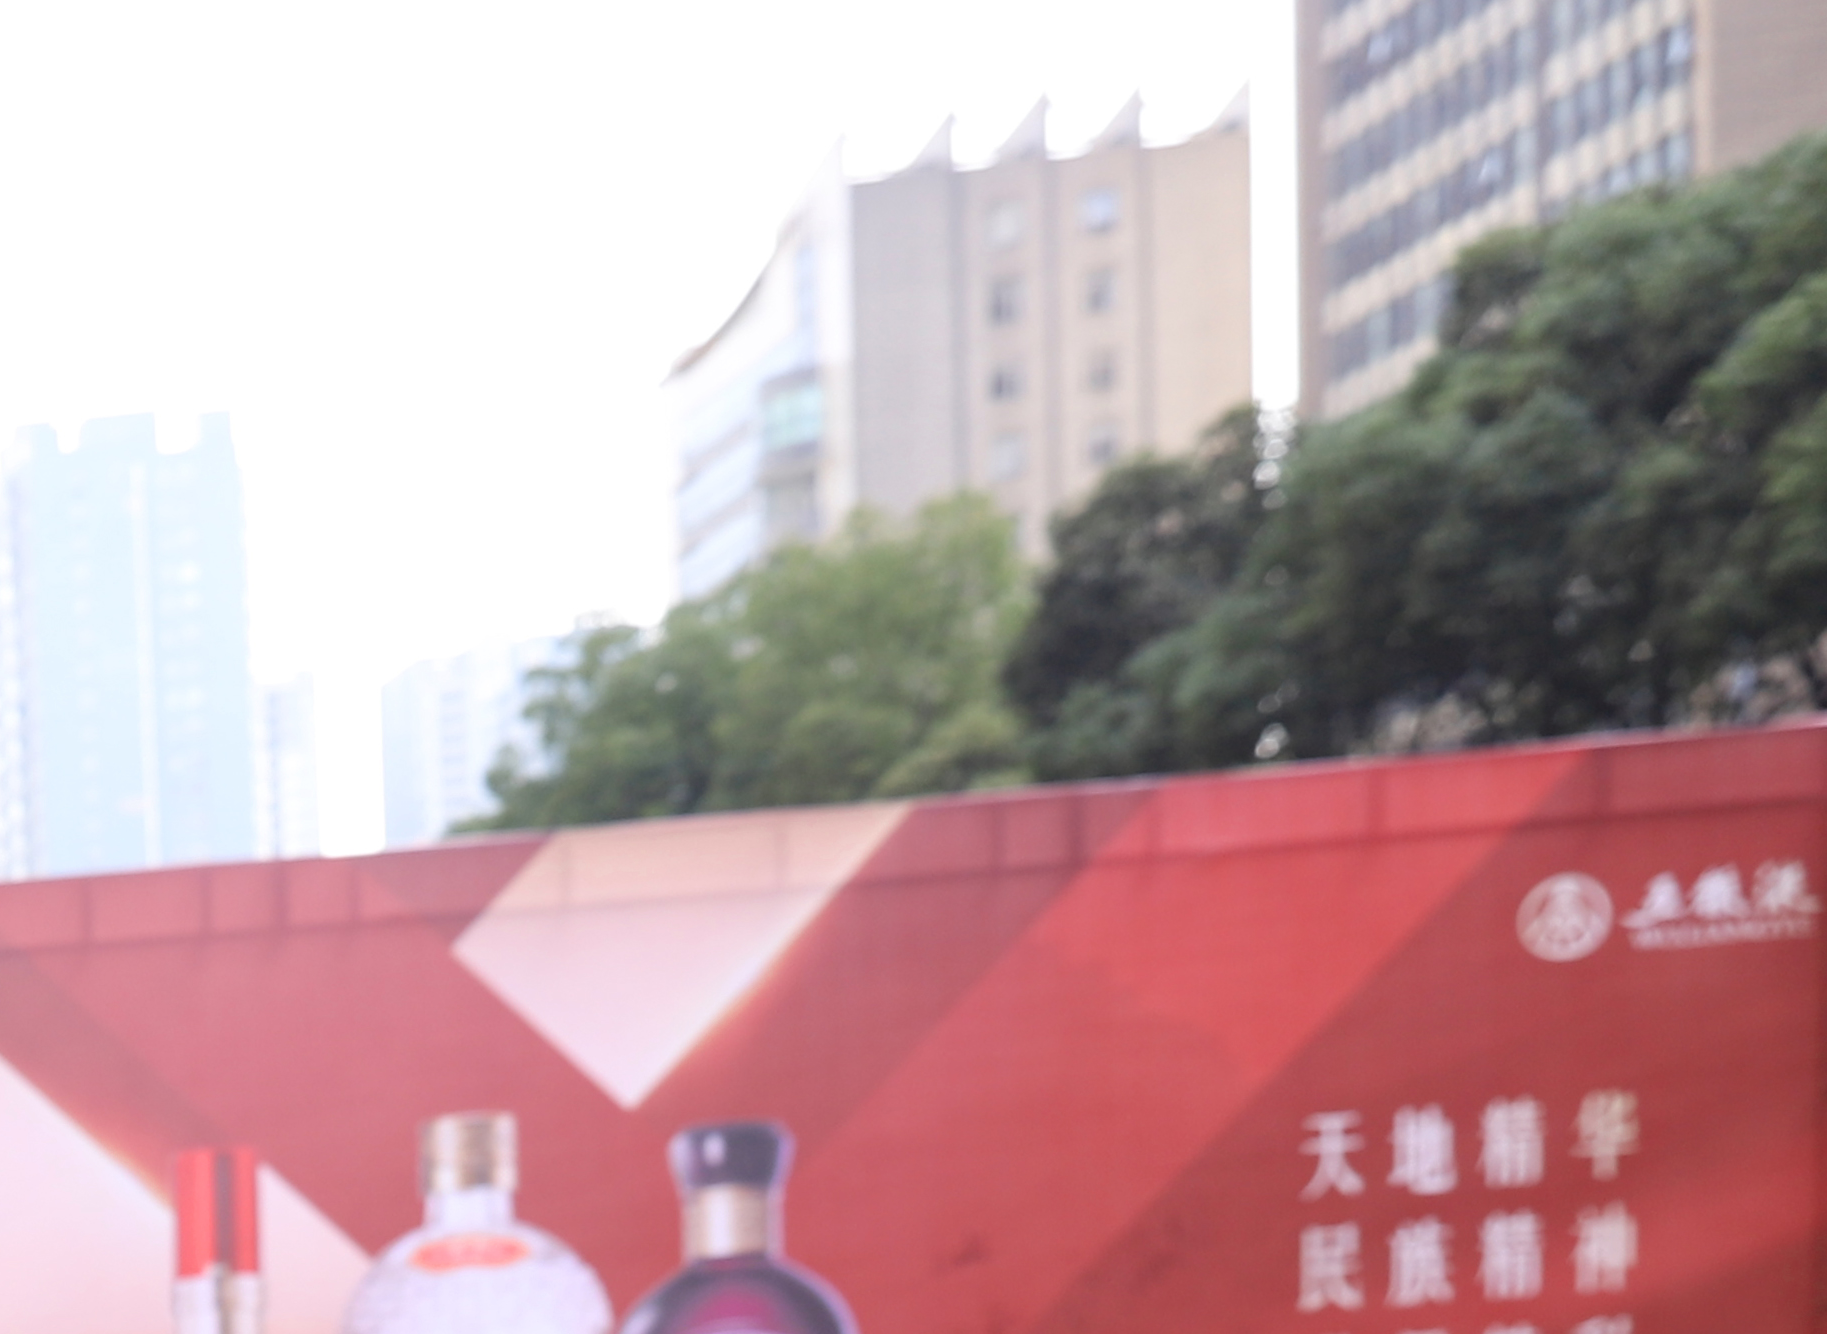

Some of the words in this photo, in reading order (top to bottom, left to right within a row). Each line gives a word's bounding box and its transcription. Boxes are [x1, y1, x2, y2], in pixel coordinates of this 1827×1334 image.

[1298, 1090, 1639, 1201] 天地精华
[1298, 1202, 1639, 1312] 民族精神
